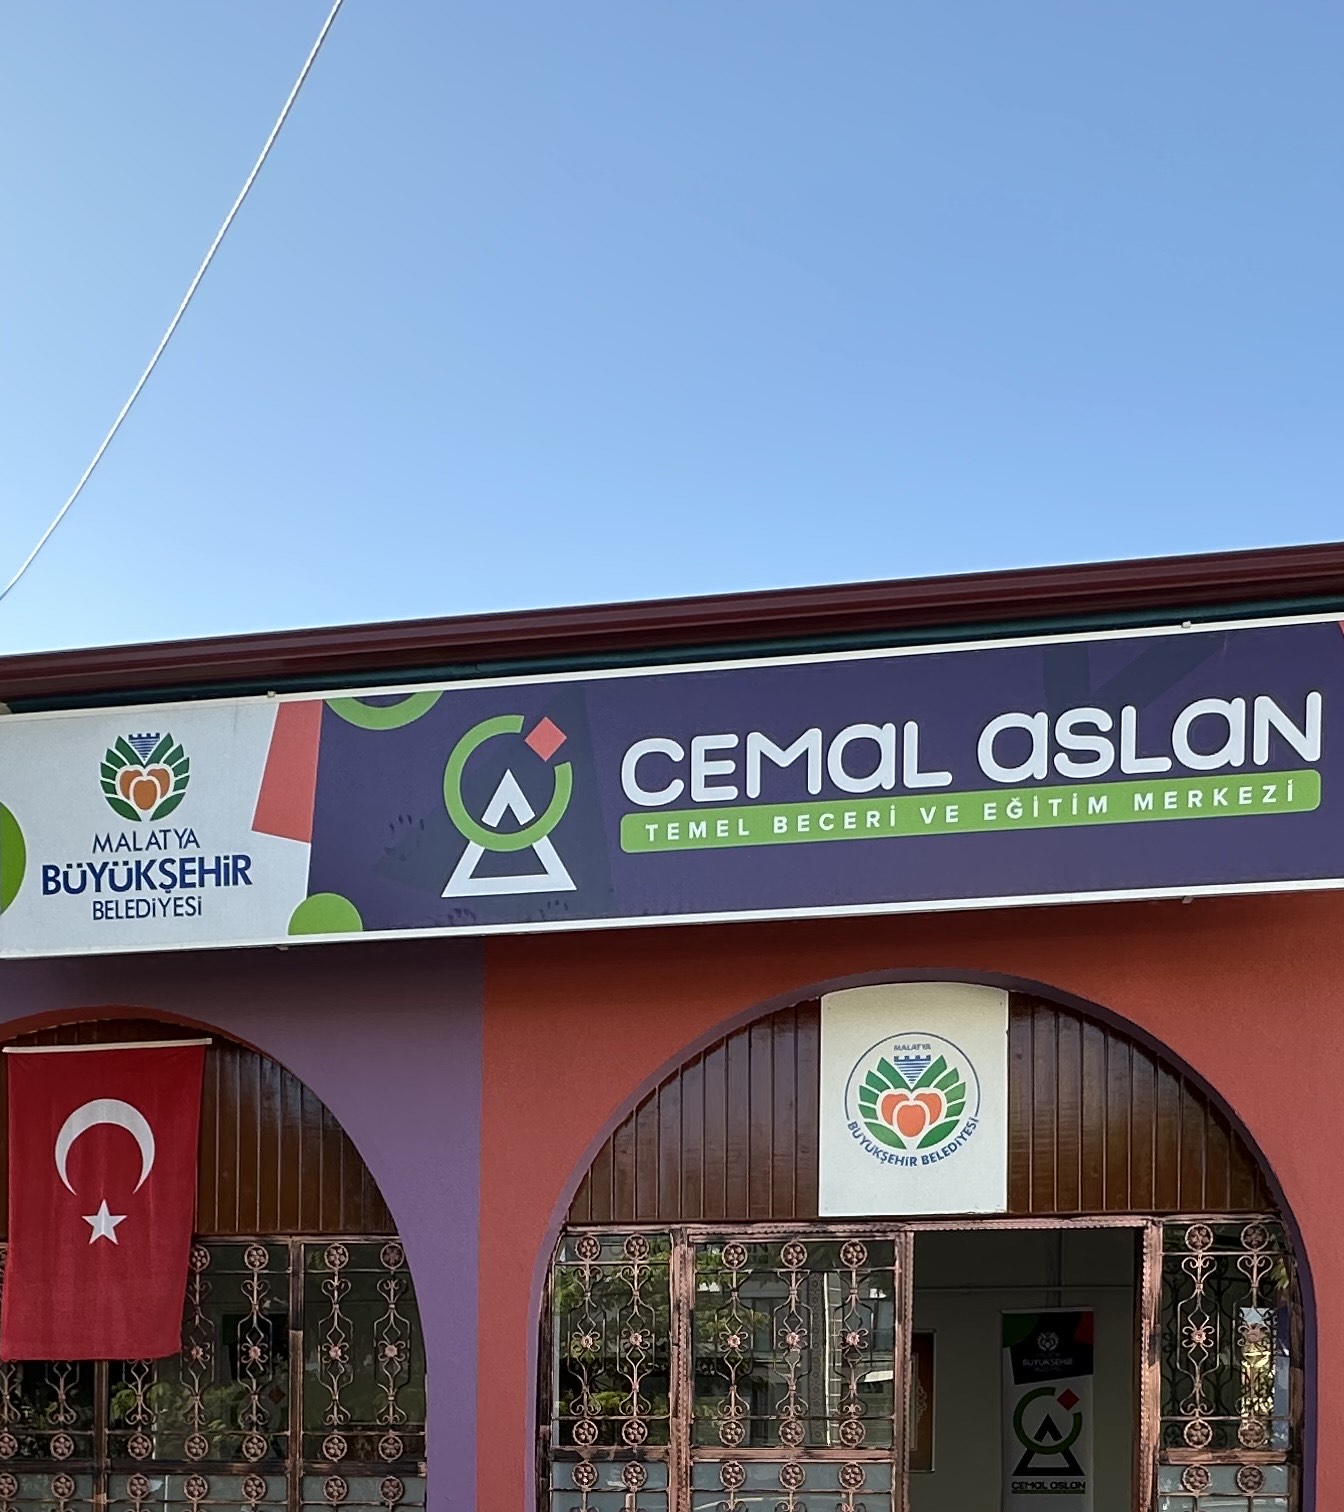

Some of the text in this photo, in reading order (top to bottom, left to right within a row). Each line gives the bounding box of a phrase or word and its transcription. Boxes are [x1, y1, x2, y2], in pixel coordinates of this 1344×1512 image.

[645, 778, 1295, 842] TEMEL BECERİ VE EĞİTİM MERKEZİ
[92, 828, 201, 854] MALATYA
[893, 1043, 932, 1051] MALATYA
